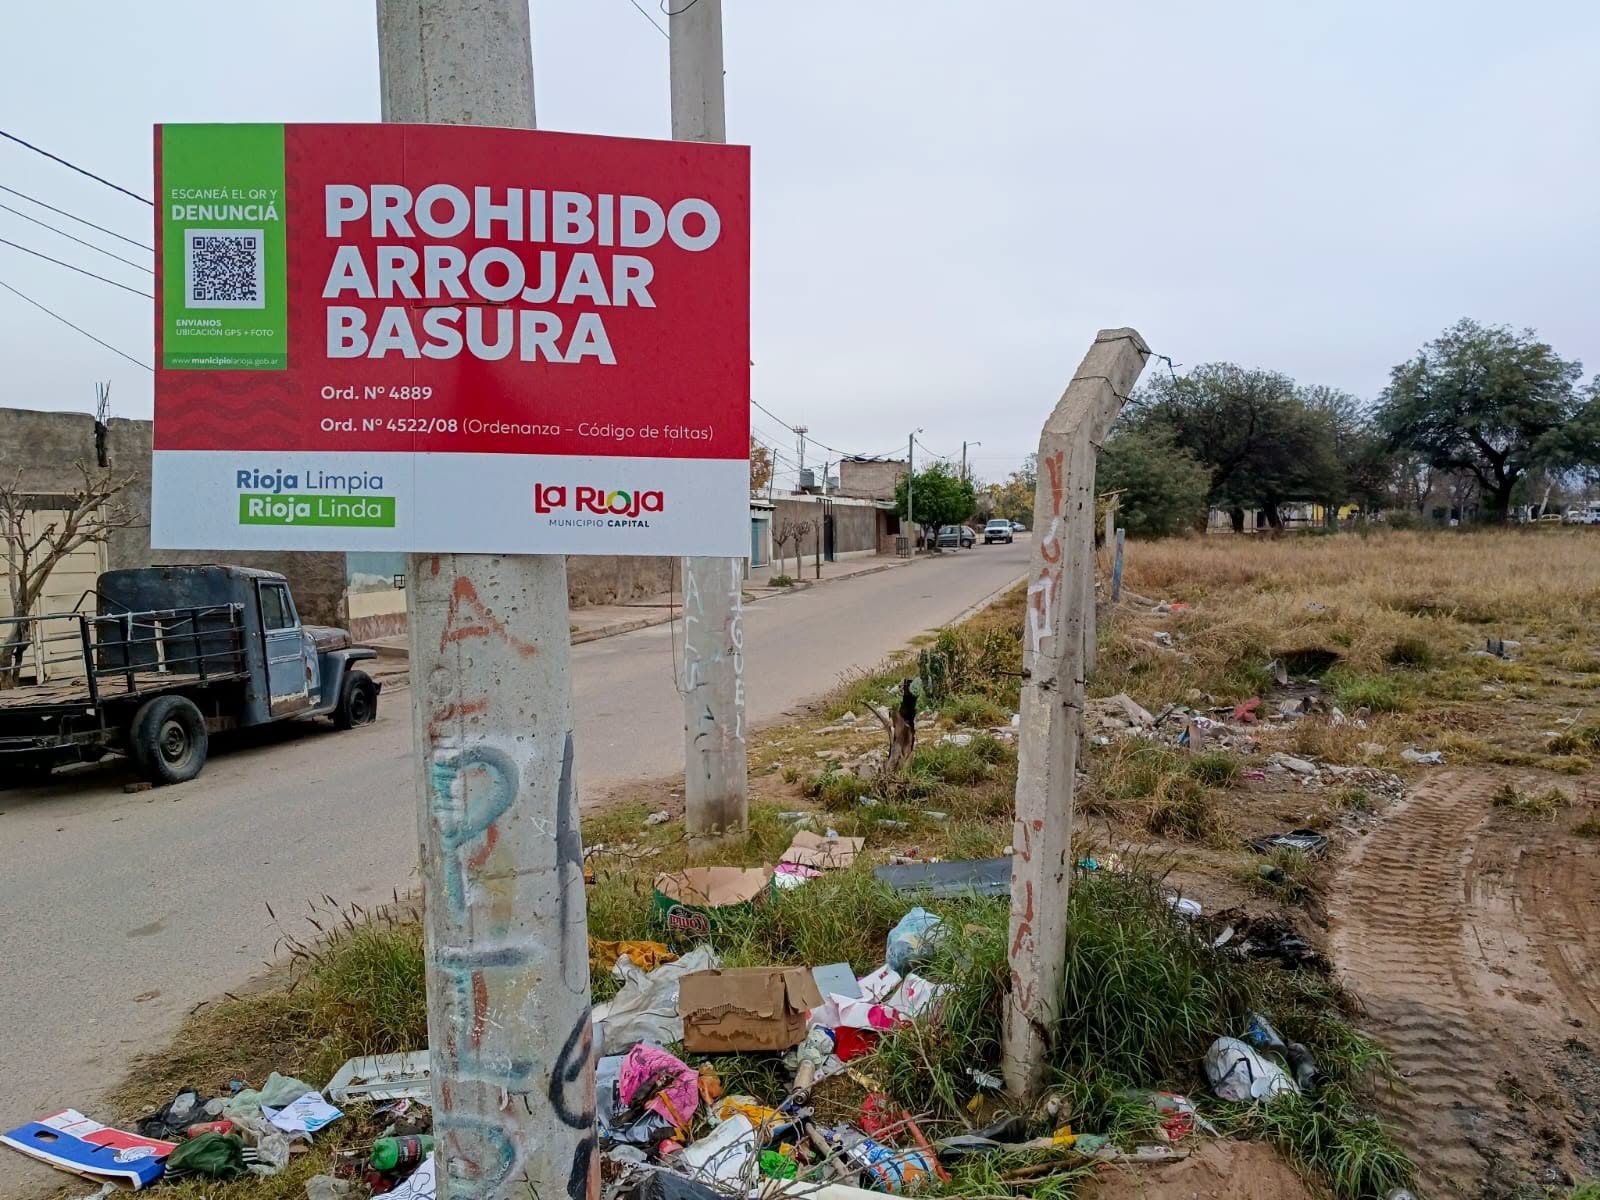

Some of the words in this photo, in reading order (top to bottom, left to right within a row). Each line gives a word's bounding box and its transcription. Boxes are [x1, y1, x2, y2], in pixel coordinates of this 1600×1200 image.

[171, 186, 229, 200] ESCANEÁ
[231, 189, 246, 200] EL
[249, 189, 267, 201] QR
[269, 189, 278, 201] Y
[171, 200, 279, 221] DENUNCIÁ
[324, 183, 721, 252] PROHIBIDO
[321, 245, 657, 308] ARROJAR
[175, 327, 223, 337] UBICACIÓN
[224, 328, 242, 337] GPS
[250, 328, 275, 337] FOTO
[326, 304, 618, 366] BASURA
[320, 385, 359, 401] Ord.
[388, 386, 433, 401] 4889
[320, 417, 358, 432] Ord.
[386, 417, 459, 434] 4522/08
[462, 417, 561, 436] (Ordenanza
[577, 422, 636, 441] Código
[639, 424, 660, 439] de
[663, 424, 715, 442] faltas)
[236, 468, 299, 494] Rioja
[306, 470, 384, 495] Limpia
[248, 496, 311, 523] Rioja
[318, 498, 382, 519] Linda
[548, 519, 604, 528] MUNICIPIO
[606, 519, 651, 528] CAPITAL
